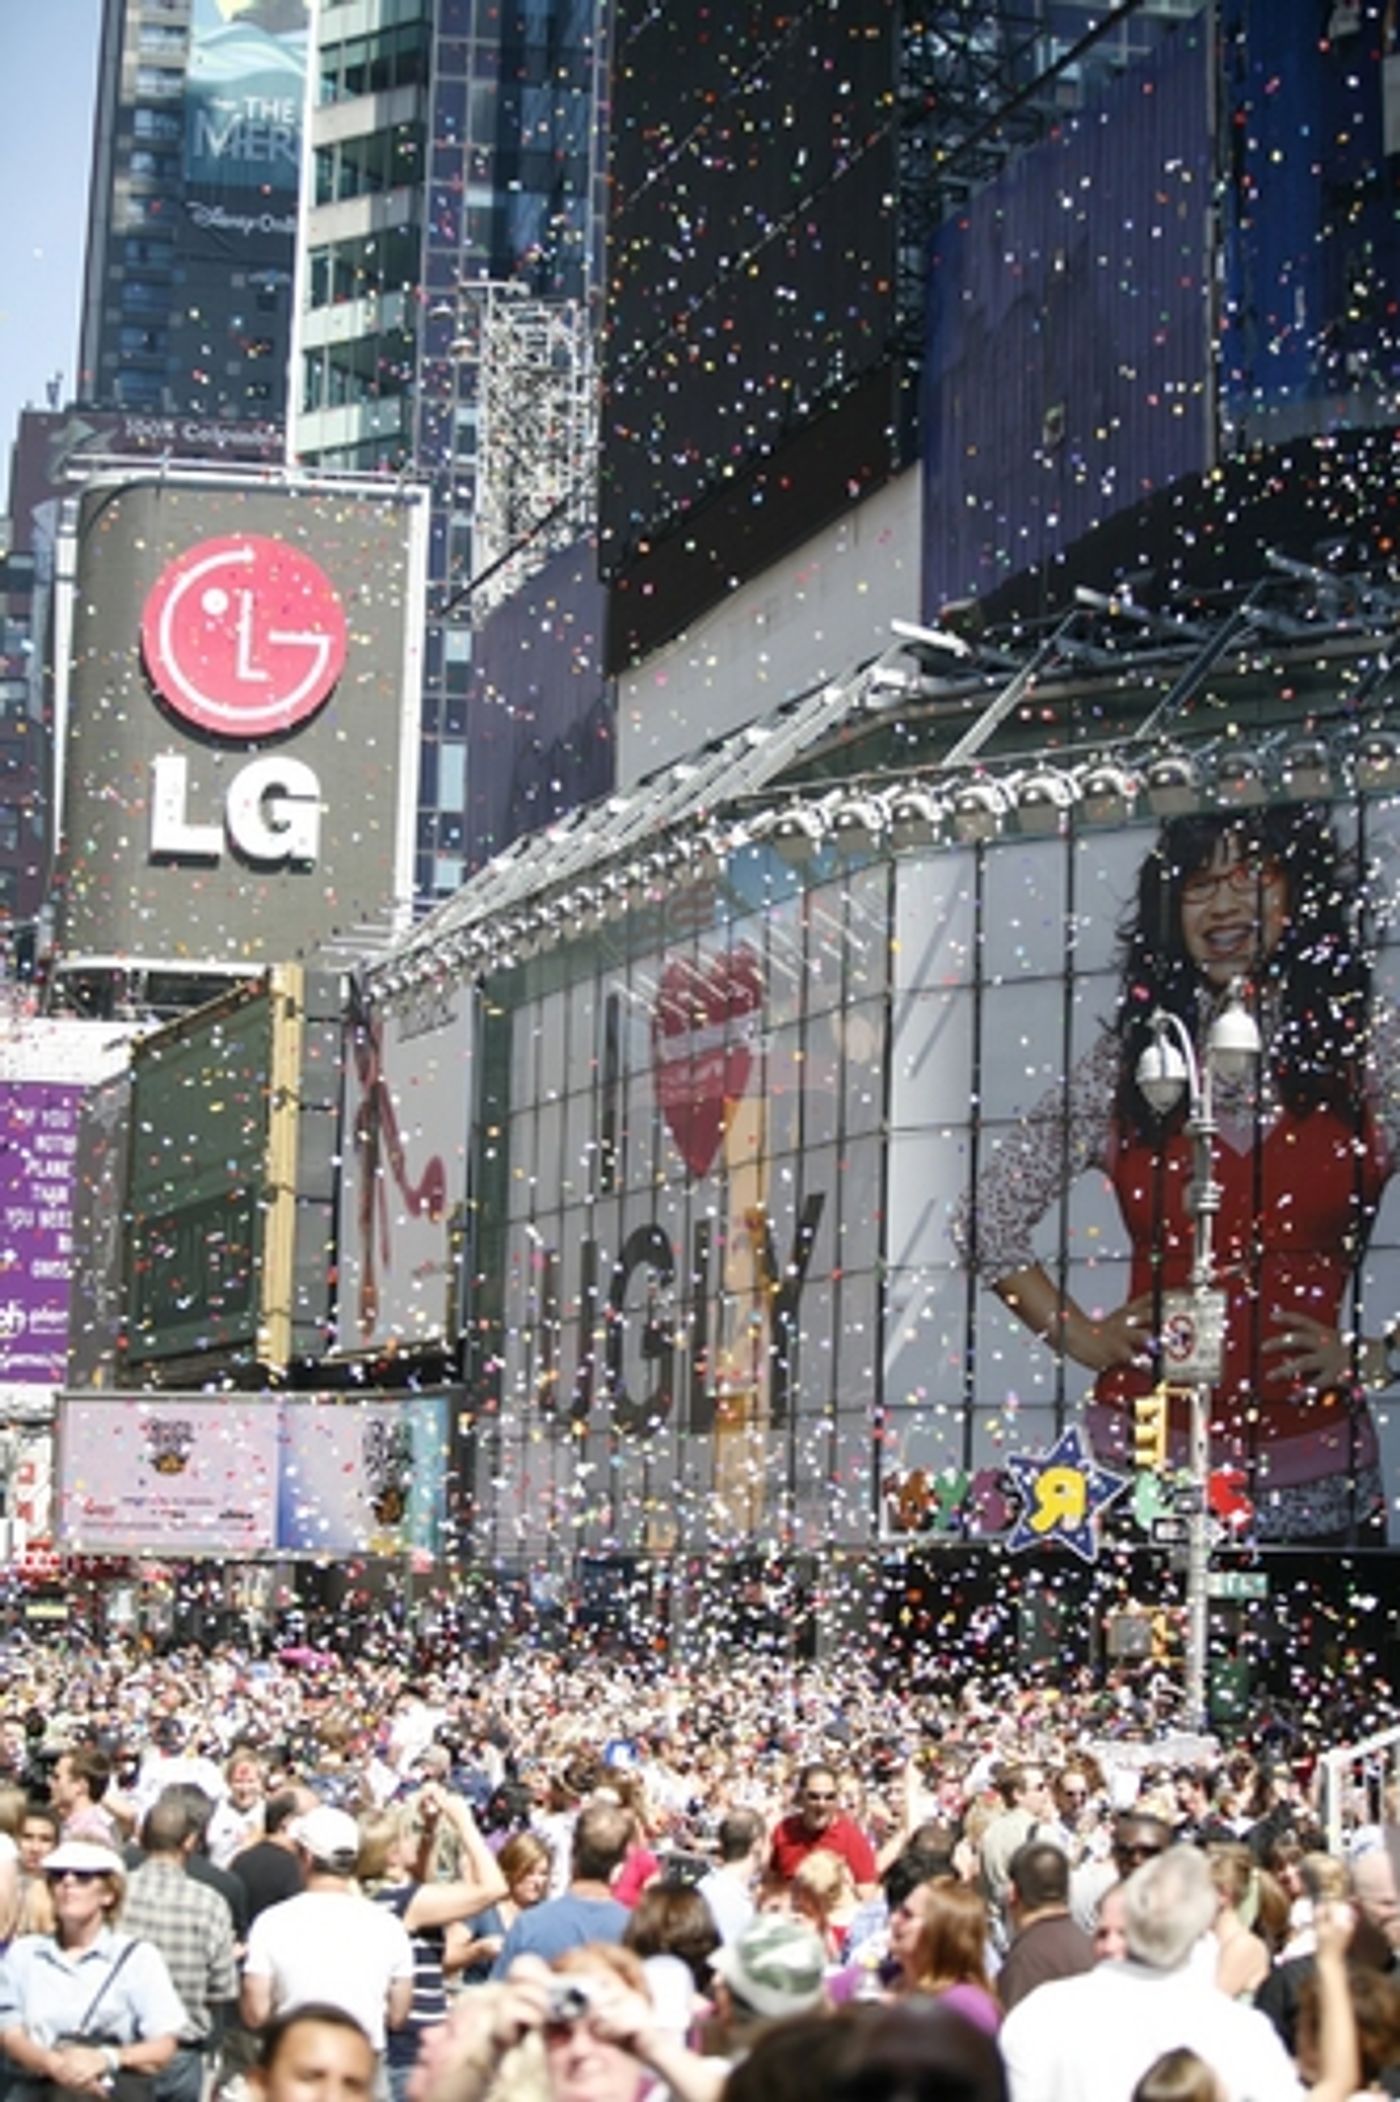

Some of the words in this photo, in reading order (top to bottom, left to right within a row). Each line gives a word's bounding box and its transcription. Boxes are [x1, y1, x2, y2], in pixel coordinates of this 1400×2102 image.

[244, 96, 296, 124] THE
[149, 754, 322, 868] LG
[538, 1193, 826, 1440] UGLY
[883, 1468, 1010, 1532] OYS
